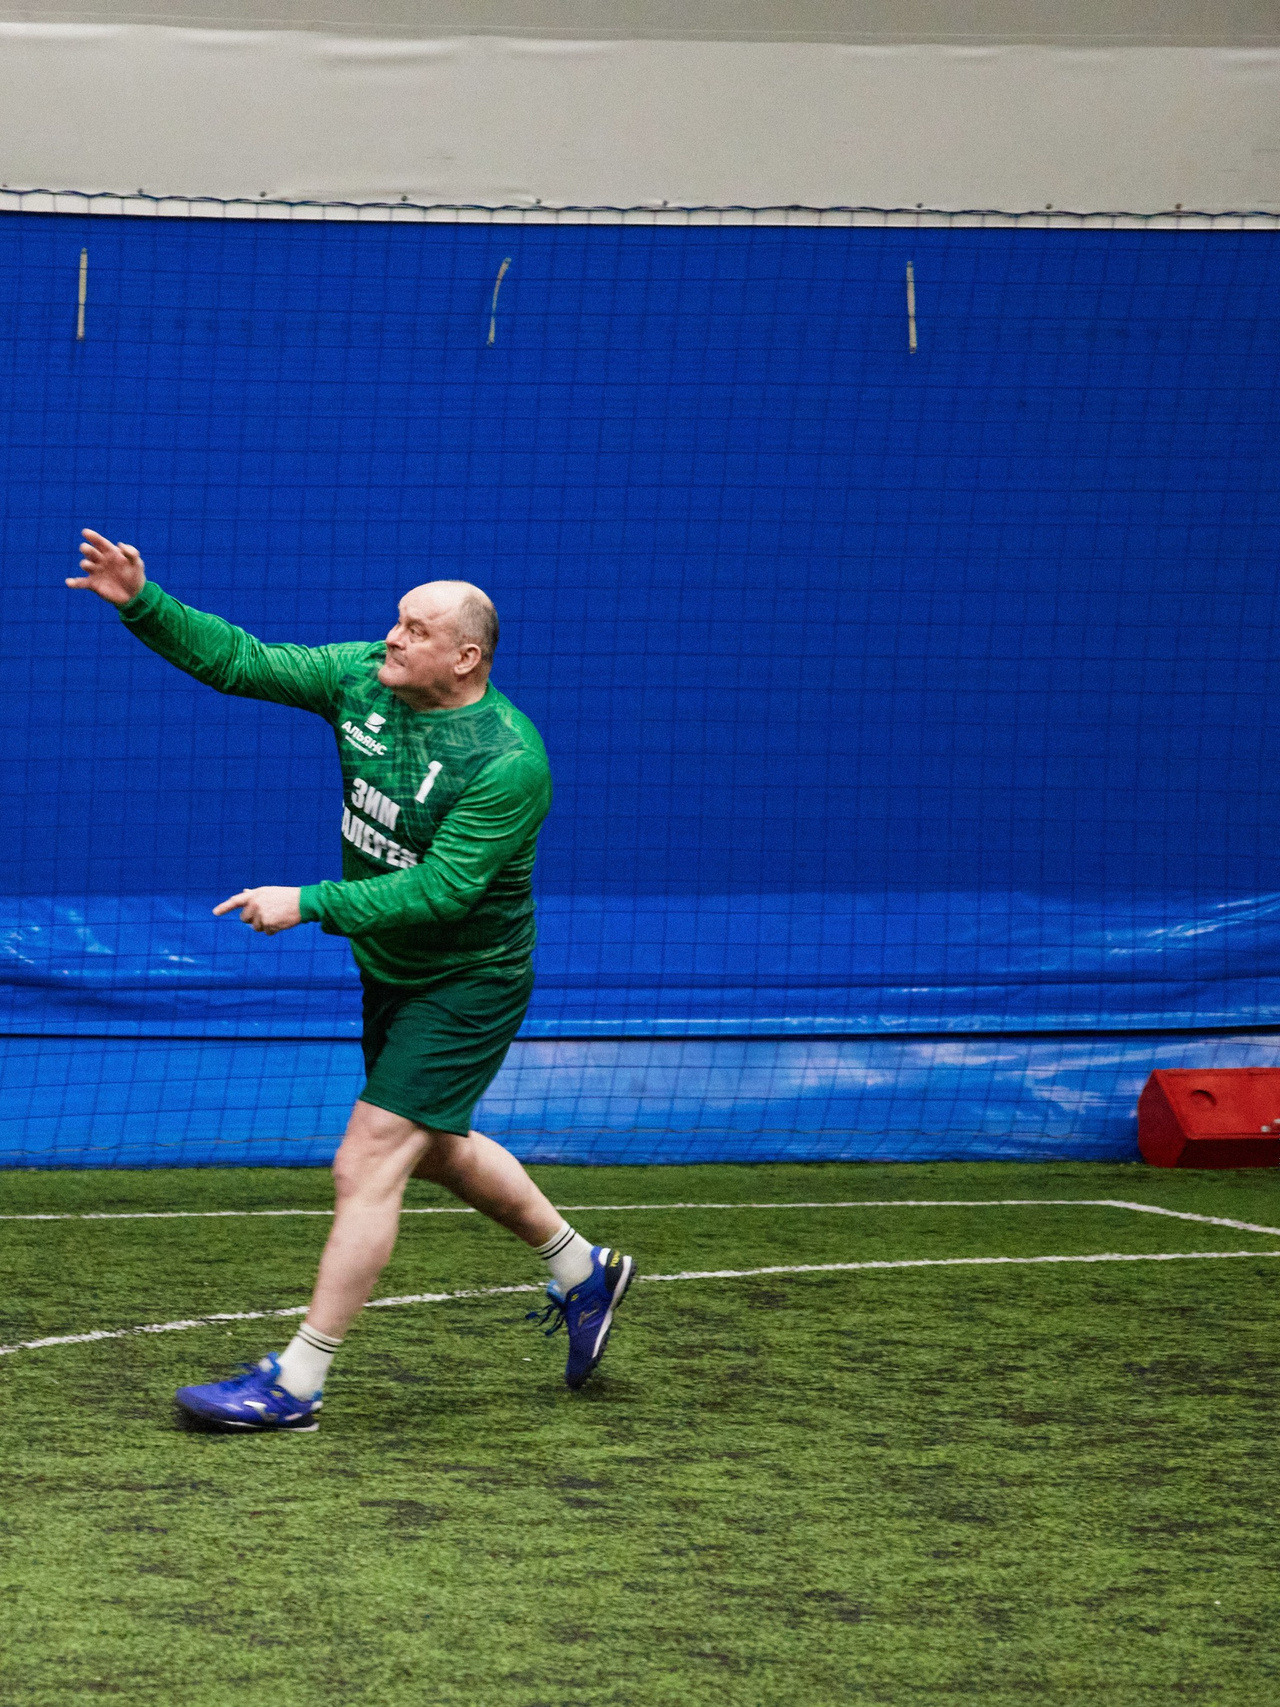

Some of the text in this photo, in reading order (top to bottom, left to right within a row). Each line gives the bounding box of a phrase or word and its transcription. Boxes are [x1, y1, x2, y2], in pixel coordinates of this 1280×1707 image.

[341, 720, 388, 756] АЛЬЯНС
[415, 760, 443, 804] 1
[351, 778, 400, 831] ЗИМ
